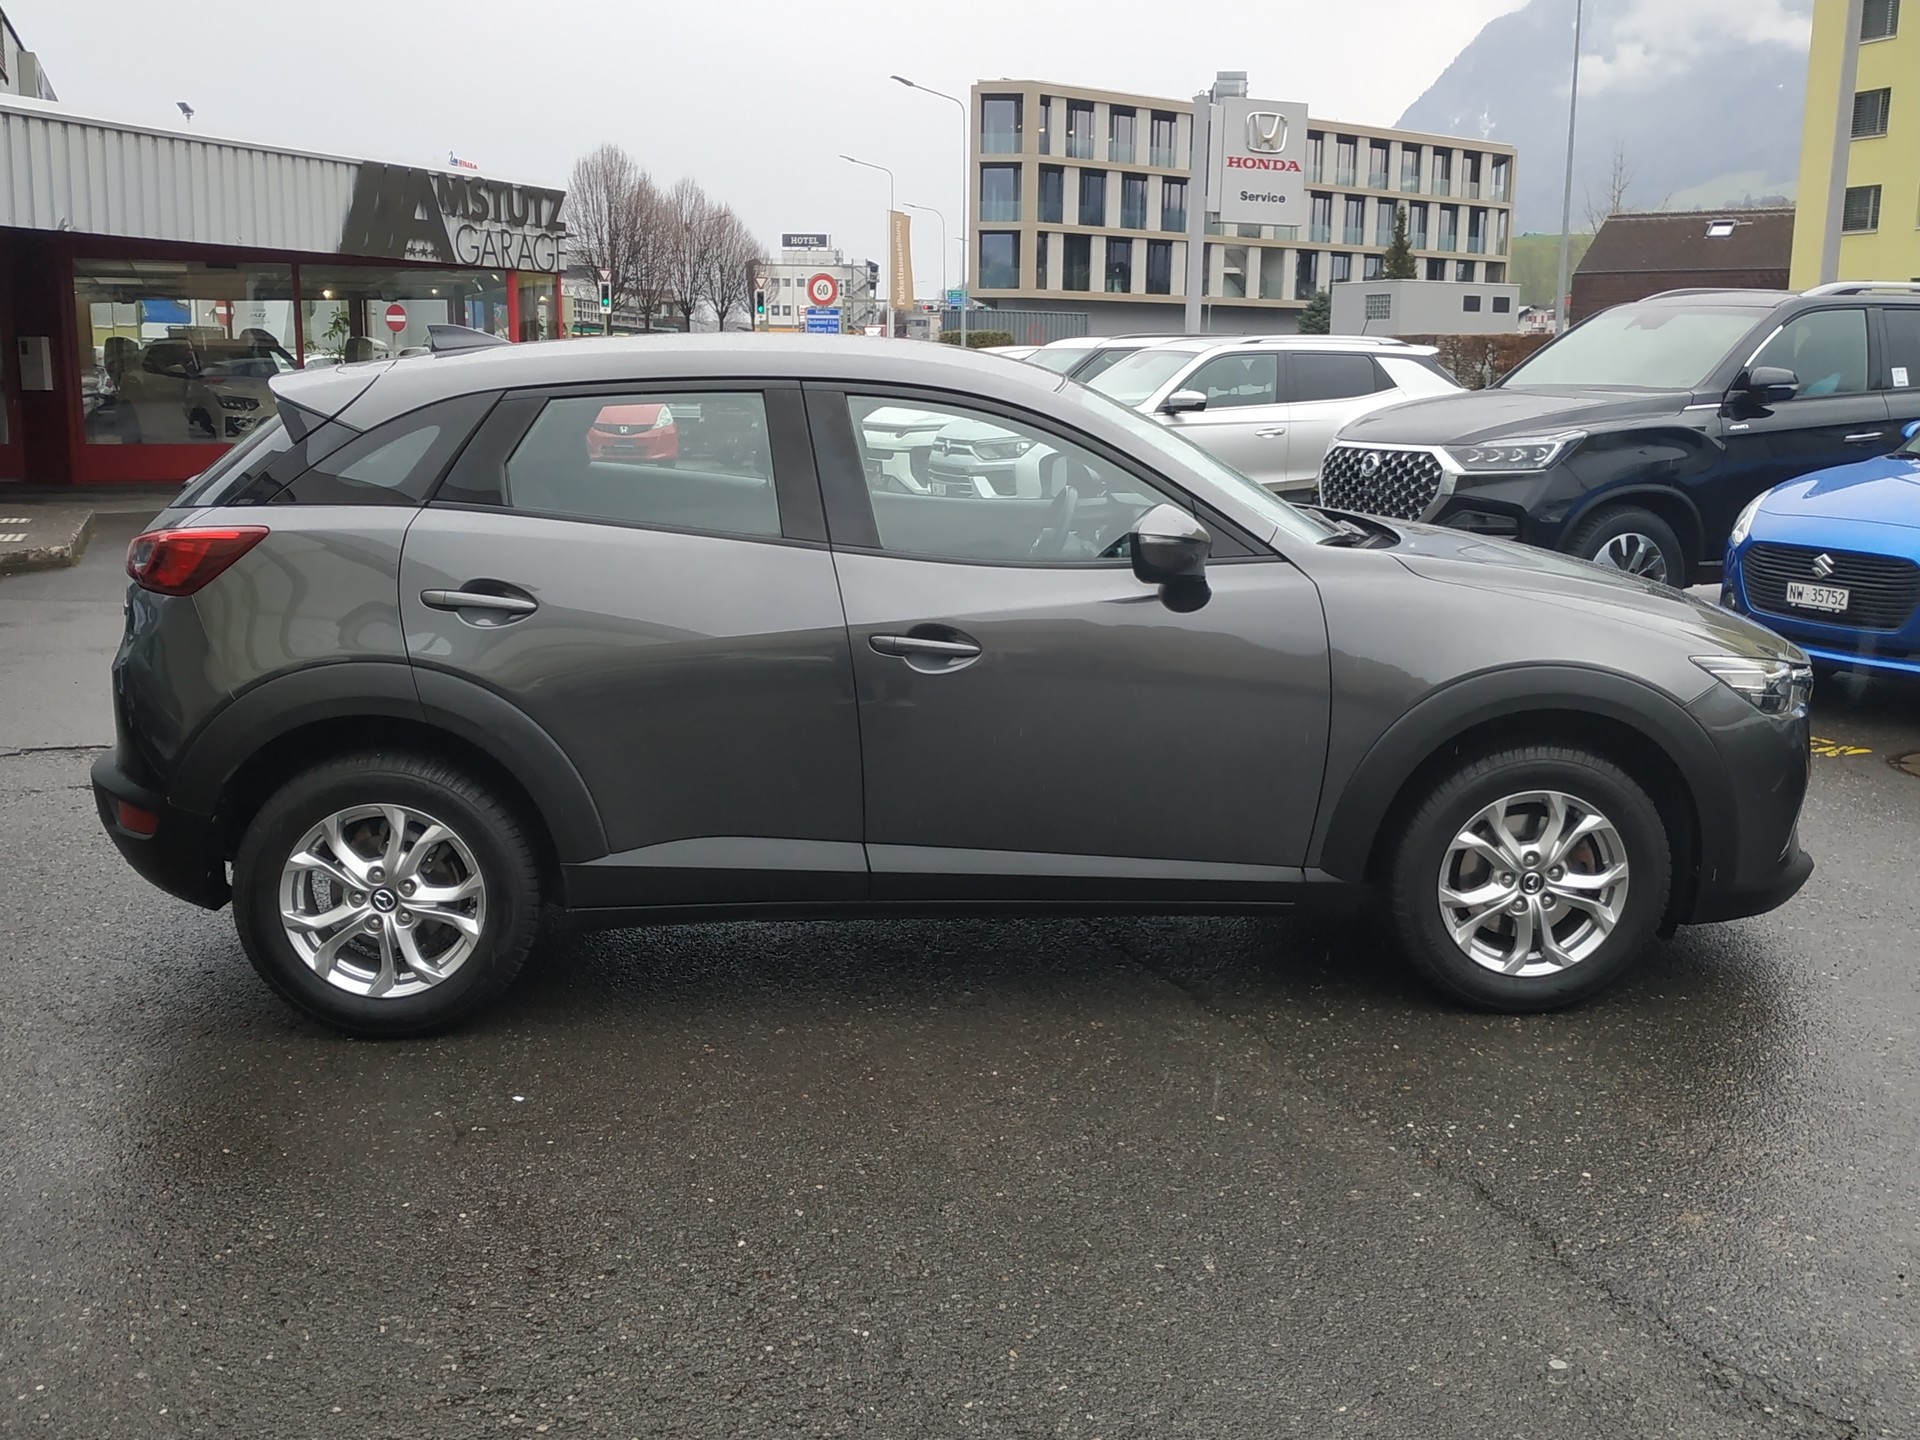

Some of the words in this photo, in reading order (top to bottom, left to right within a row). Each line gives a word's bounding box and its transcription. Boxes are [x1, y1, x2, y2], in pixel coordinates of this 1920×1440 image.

[1226, 156, 1302, 173] HONDA
[1240, 191, 1286, 203] Service
[790, 236, 819, 245] HOTEL
[456, 224, 567, 272] GARAGE
[816, 284, 829, 296] 60
[1789, 585, 1805, 600] NW
[1811, 588, 1845, 606] 35752
